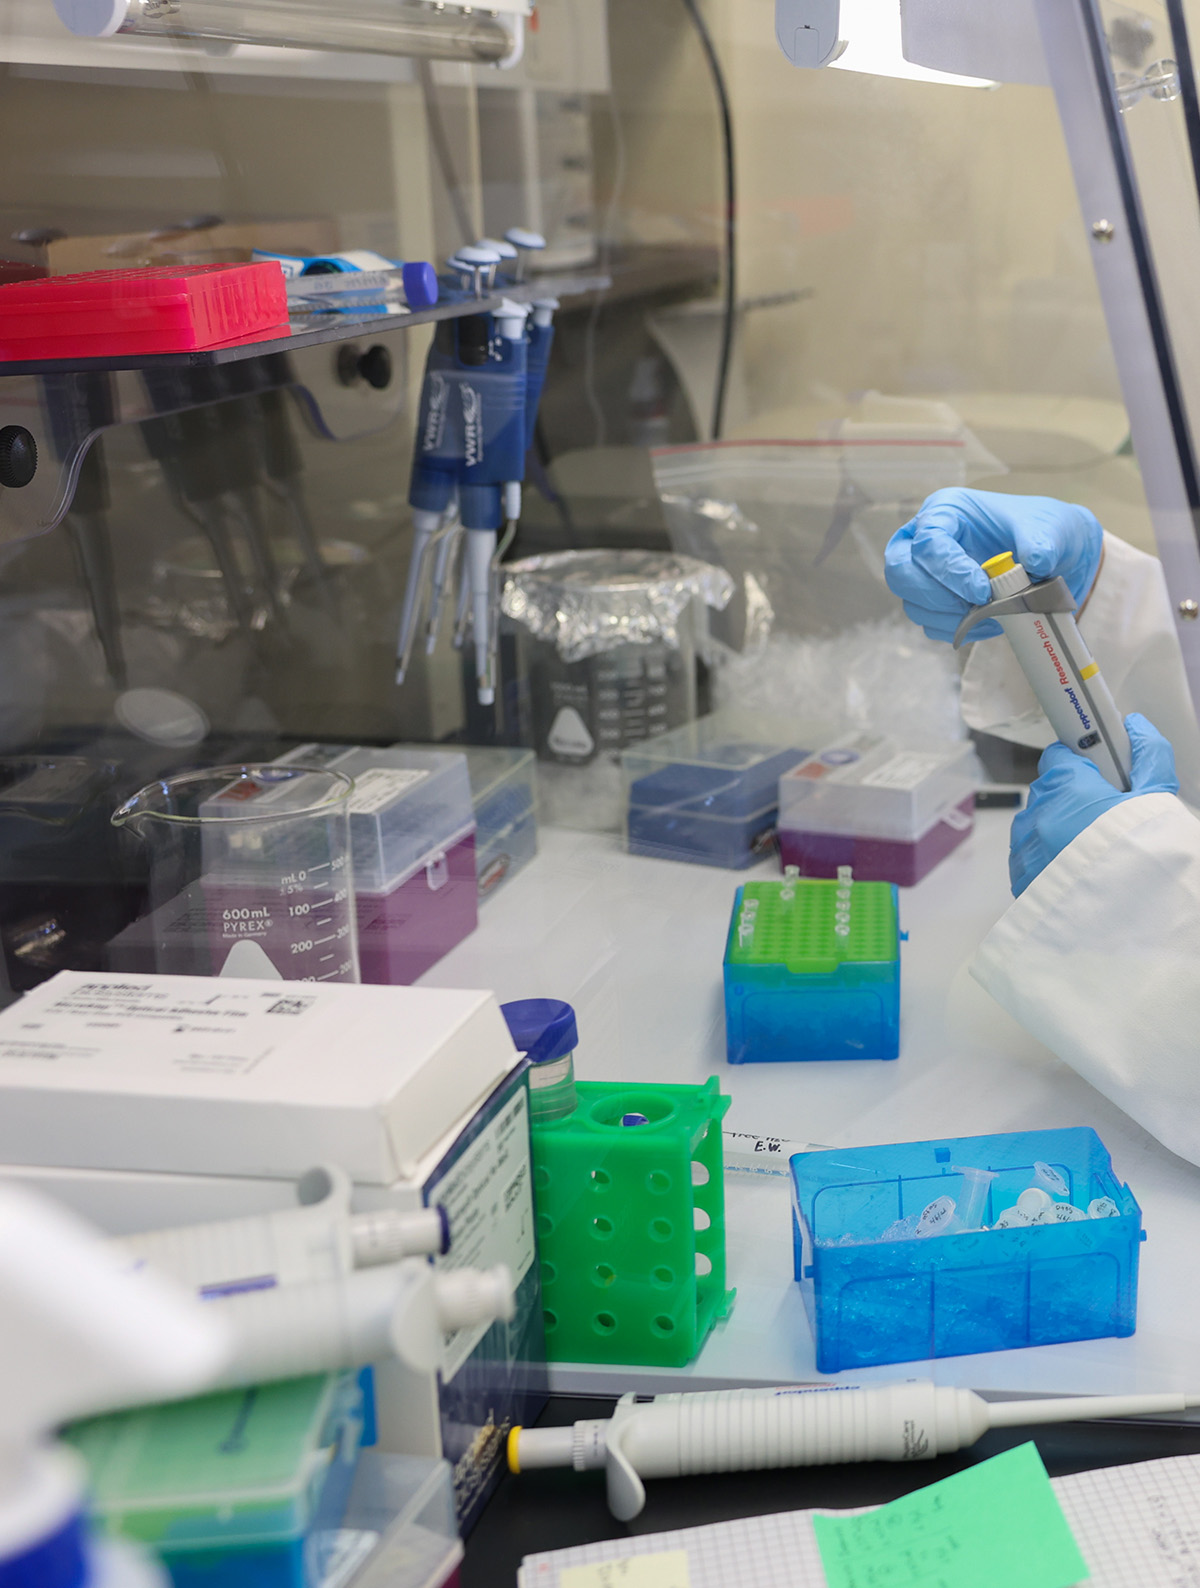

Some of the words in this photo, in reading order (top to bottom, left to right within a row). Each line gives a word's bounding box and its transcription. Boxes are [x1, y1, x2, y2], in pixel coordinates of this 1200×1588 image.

[1033, 619, 1050, 640] plus
[1043, 640, 1069, 686] Research
[1064, 687, 1091, 731] eppendorf
[281, 873, 297, 885] mL
[289, 903, 310, 916] 100
[291, 940, 313, 954] 200
[754, 1140, 782, 1153] E.W.
